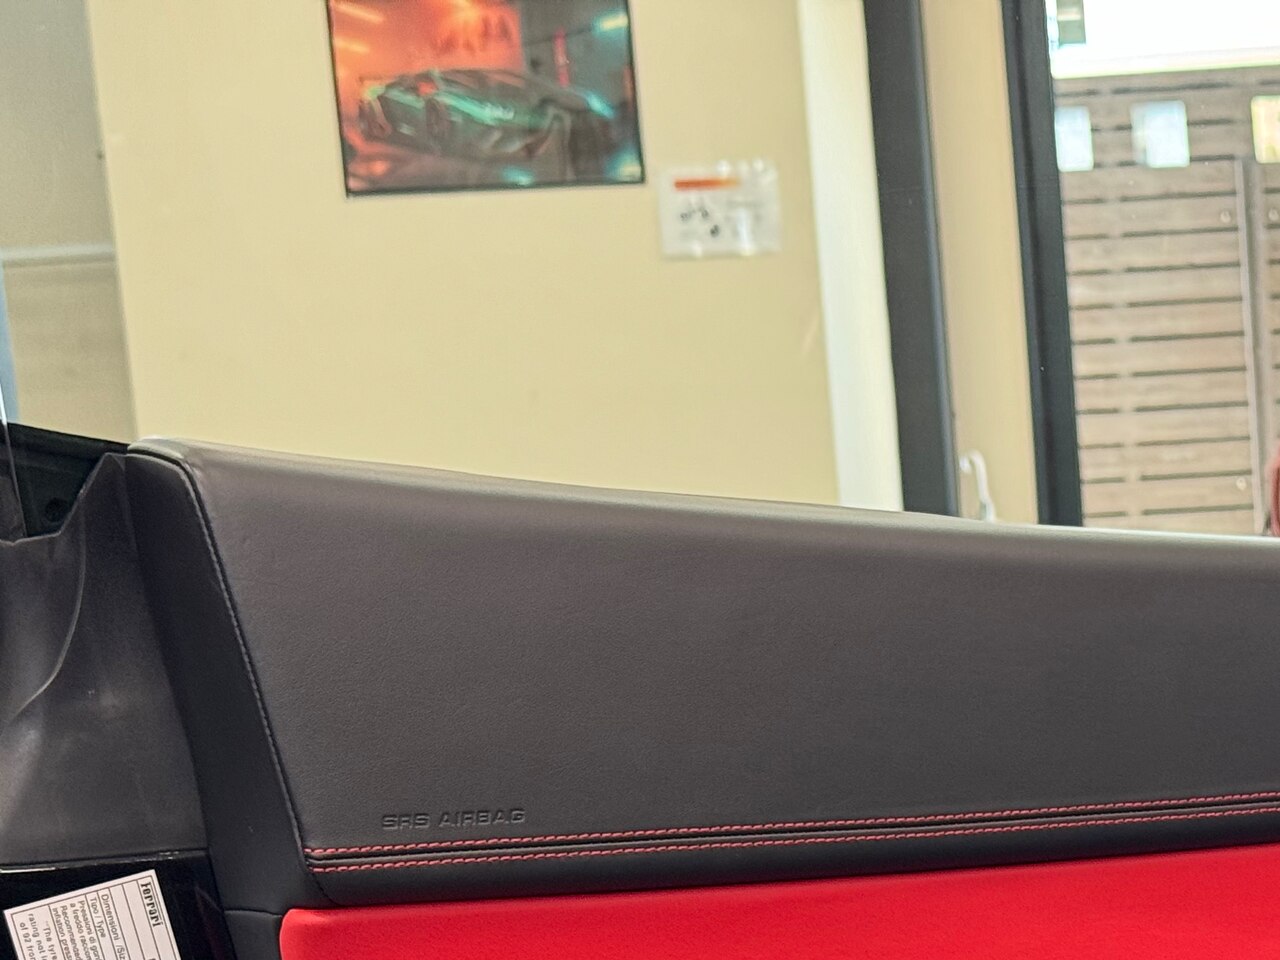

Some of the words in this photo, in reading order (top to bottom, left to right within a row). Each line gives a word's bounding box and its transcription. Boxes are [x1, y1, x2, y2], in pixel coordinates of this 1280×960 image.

[382, 814, 430, 830] SRS
[438, 808, 526, 828] AIRBAG
[77, 899, 93, 935] Pressioni
[88, 935, 96, 944] di
[87, 896, 100, 914] Tipo
[94, 919, 107, 938] Type
[100, 893, 121, 941] Dimensioni
[139, 881, 163, 927] Ferrari
[18, 921, 27, 930] of
[25, 912, 40, 937] rating
[35, 939, 46, 953] not
